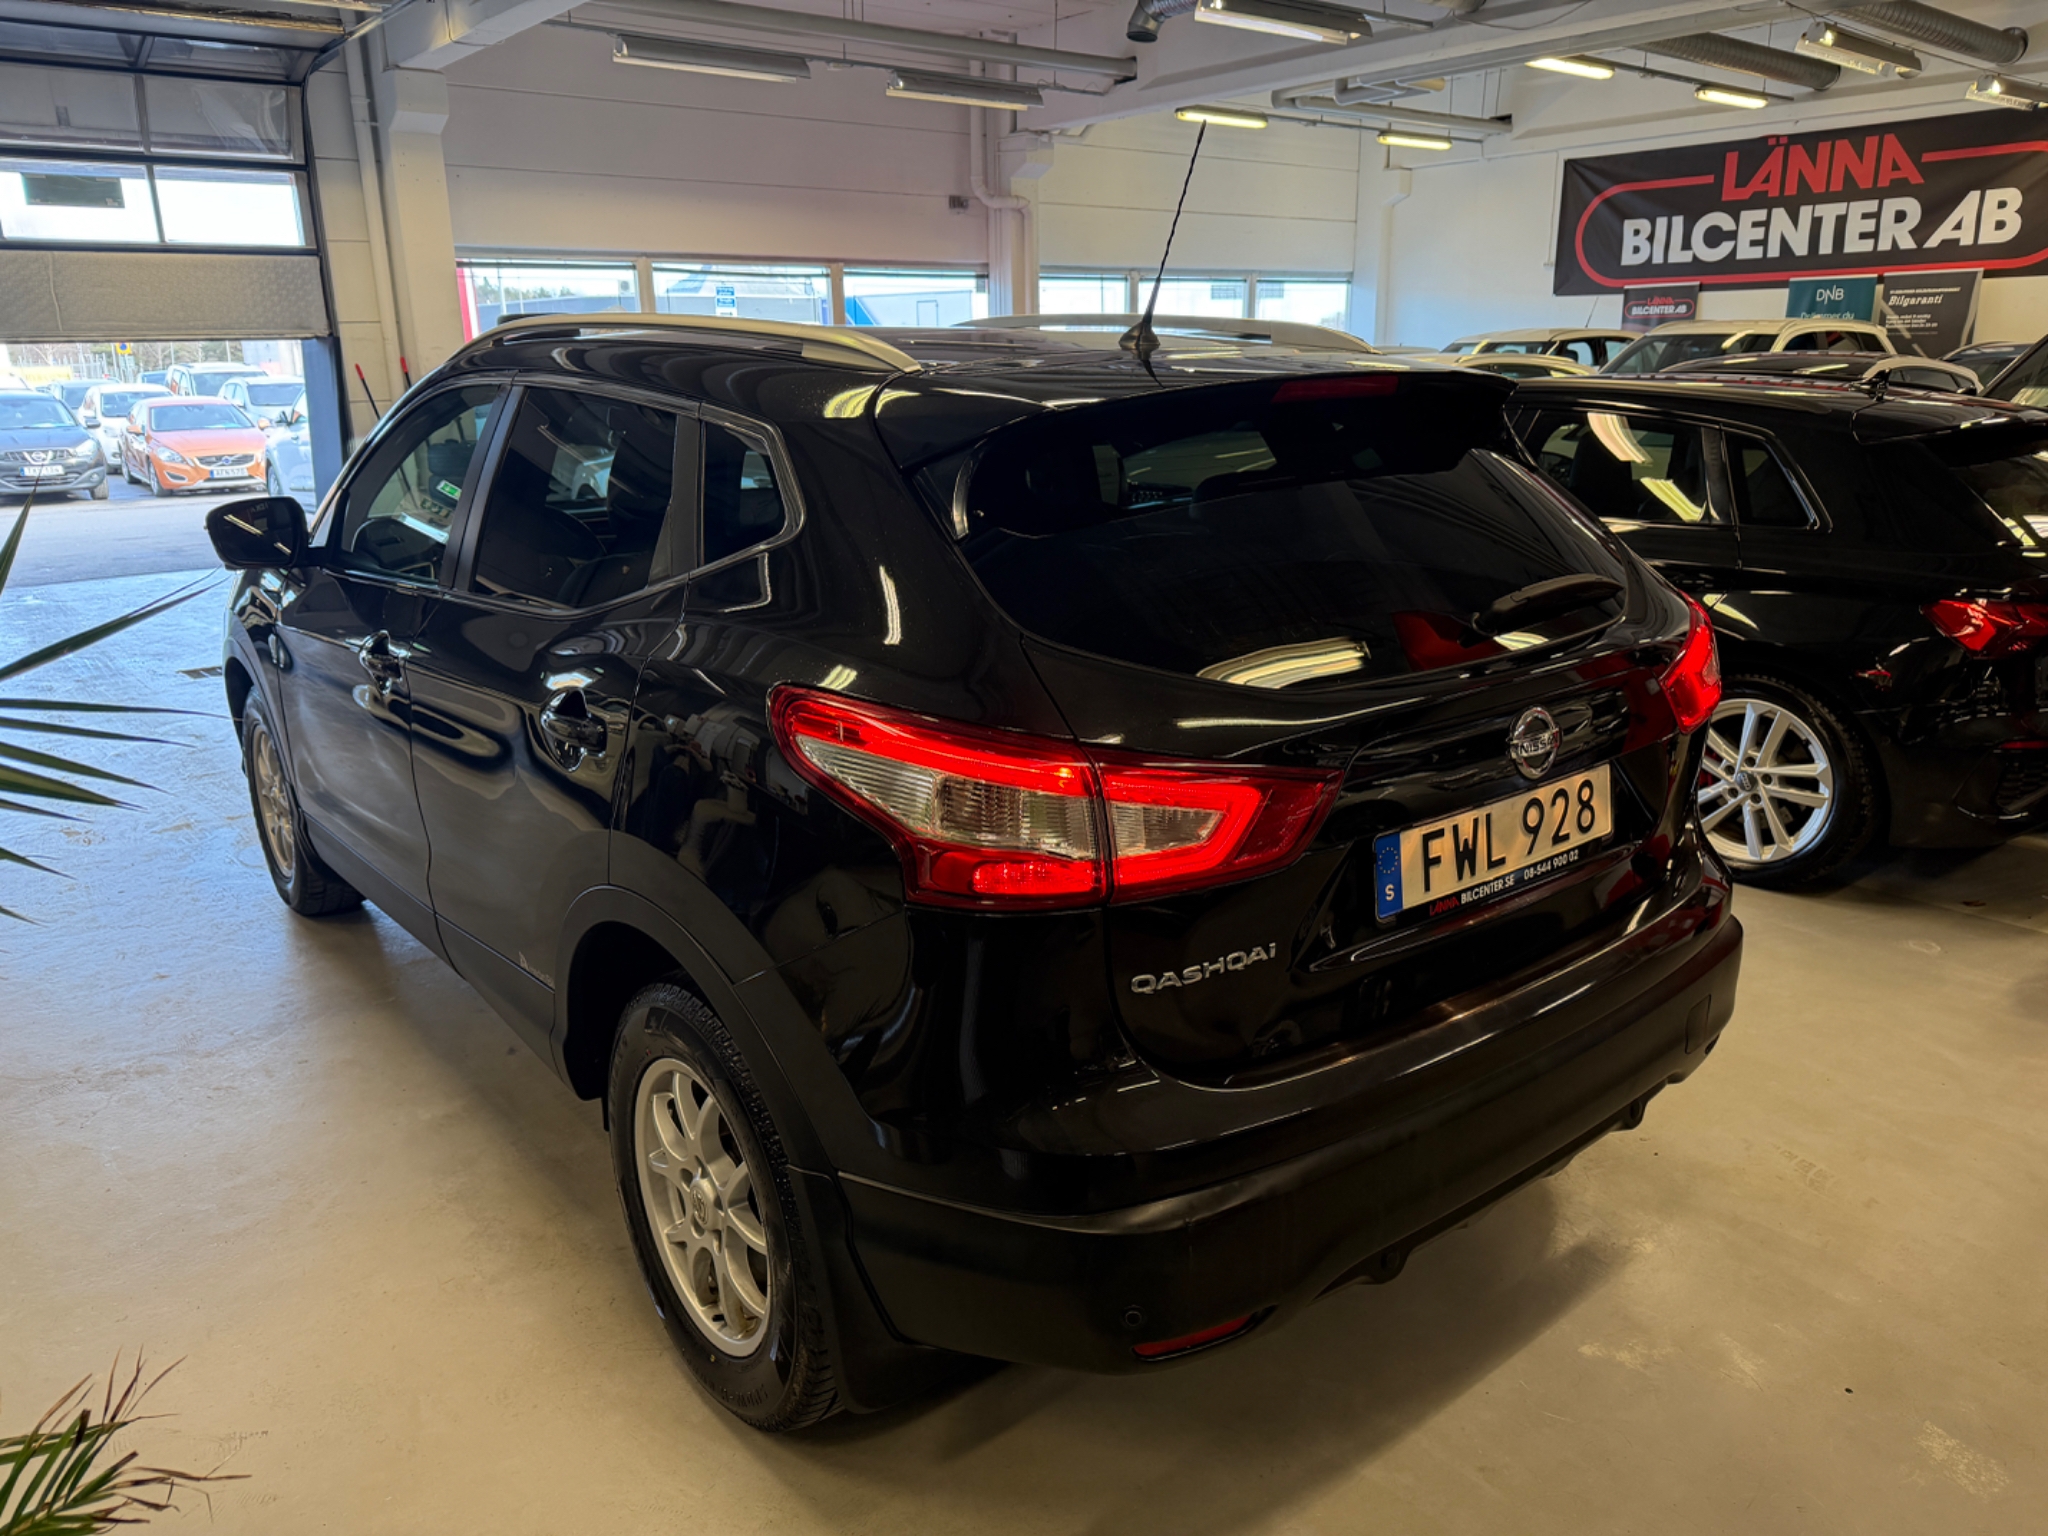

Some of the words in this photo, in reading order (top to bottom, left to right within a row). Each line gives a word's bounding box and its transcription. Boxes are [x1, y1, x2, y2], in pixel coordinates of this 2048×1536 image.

[1721, 133, 1925, 201] LÄNNA
[1620, 197, 1922, 266] BILCENTER
[1923, 187, 2023, 249] AB
[1631, 304, 1675, 315] BILCENTER
[1815, 284, 1845, 305] DNB
[1421, 813, 1506, 893] FWL
[1522, 779, 1595, 856] 928
[1523, 864, 1551, 881] 08-544
[1552, 853, 1568, 869] 900
[1569, 849, 1580, 863] 02
[1384, 884, 1395, 901] S
